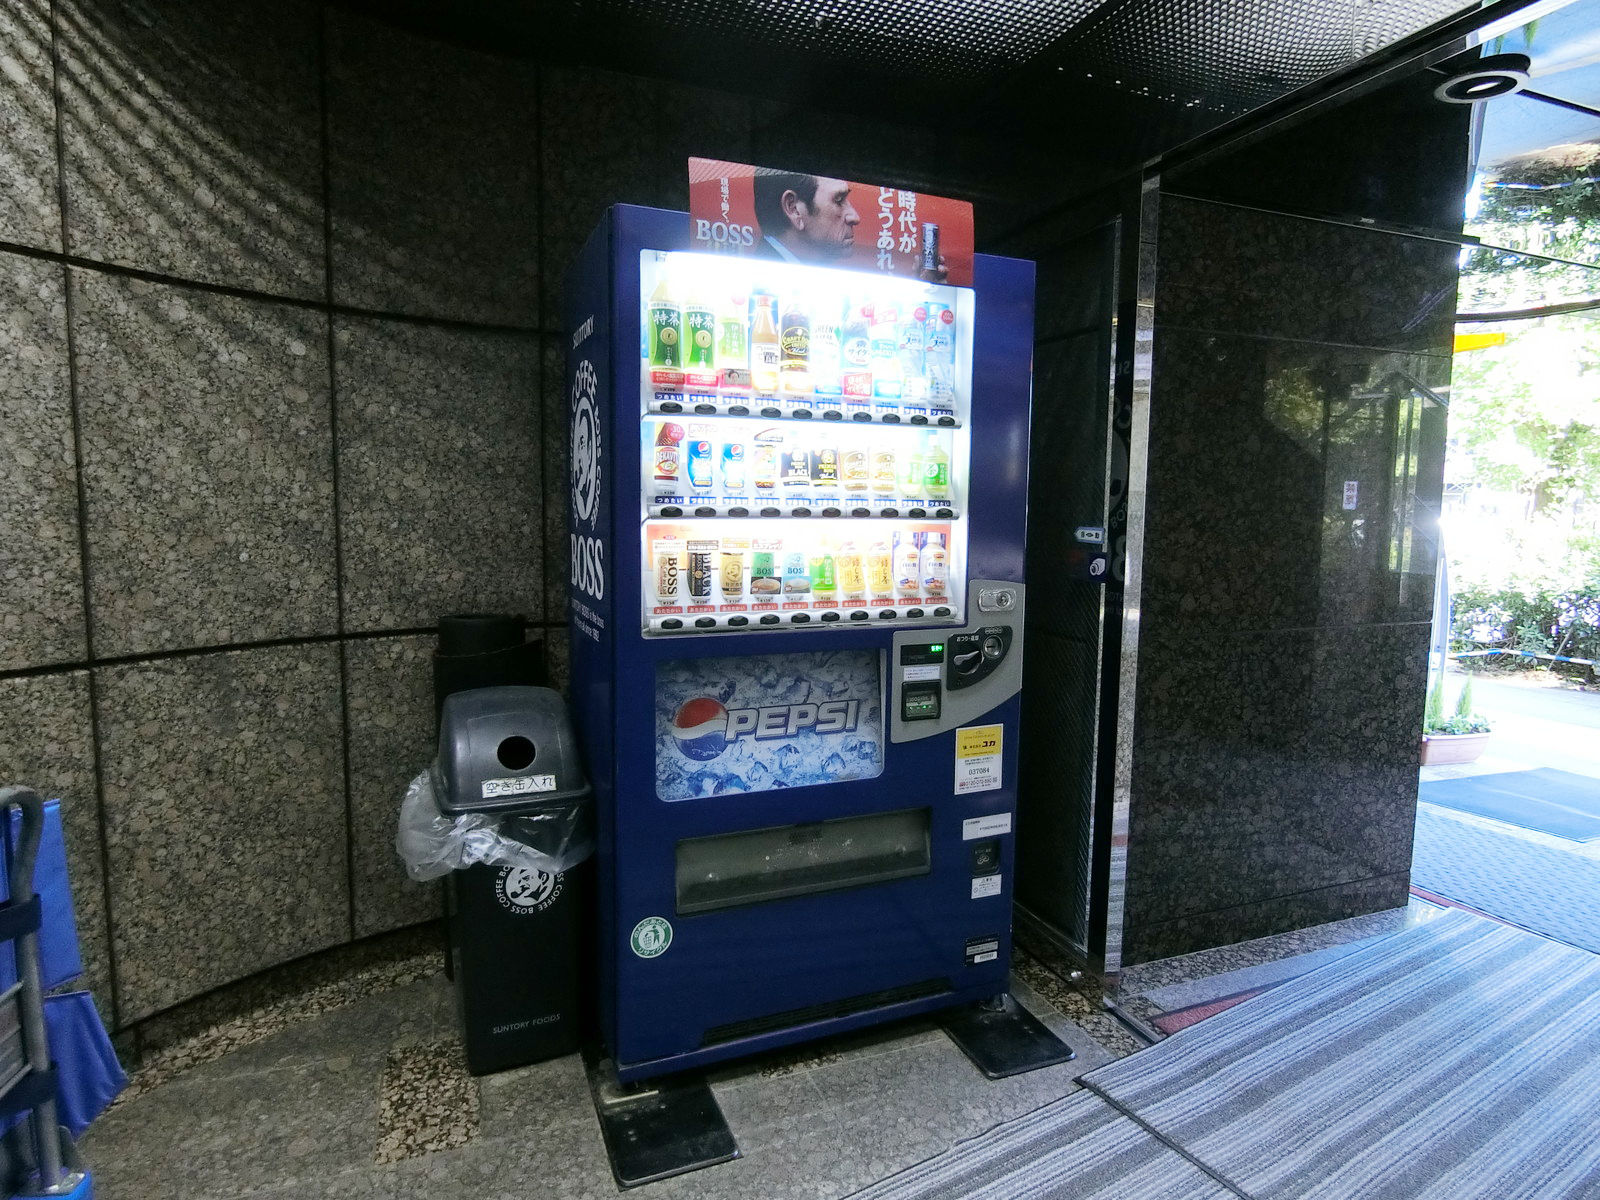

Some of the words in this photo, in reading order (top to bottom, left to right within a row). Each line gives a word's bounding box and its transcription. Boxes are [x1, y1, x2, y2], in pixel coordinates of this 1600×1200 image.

[696, 220, 754, 246] BOSS
[898, 190, 917, 254] 時代が
[654, 310, 680, 327] 特茶
[688, 313, 714, 329] 特茶
[572, 360, 598, 412] COFFEE
[571, 534, 604, 600] BOSS
[667, 557, 678, 595] BOSS
[702, 552, 712, 596] BLACK
[852, 559, 862, 585] 焙じ茶
[880, 559, 890, 585] 焙じ茶
[724, 700, 861, 743] PEPSI
[968, 766, 990, 775] 037084
[486, 776, 553, 794] 空き缶入れ
[495, 878, 510, 908] COFFEE
[538, 884, 563, 912] COFFEE
[510, 906, 534, 915] BOSS
[492, 1021, 530, 1034] SUNTORY
[532, 1013, 560, 1026] FOODS
